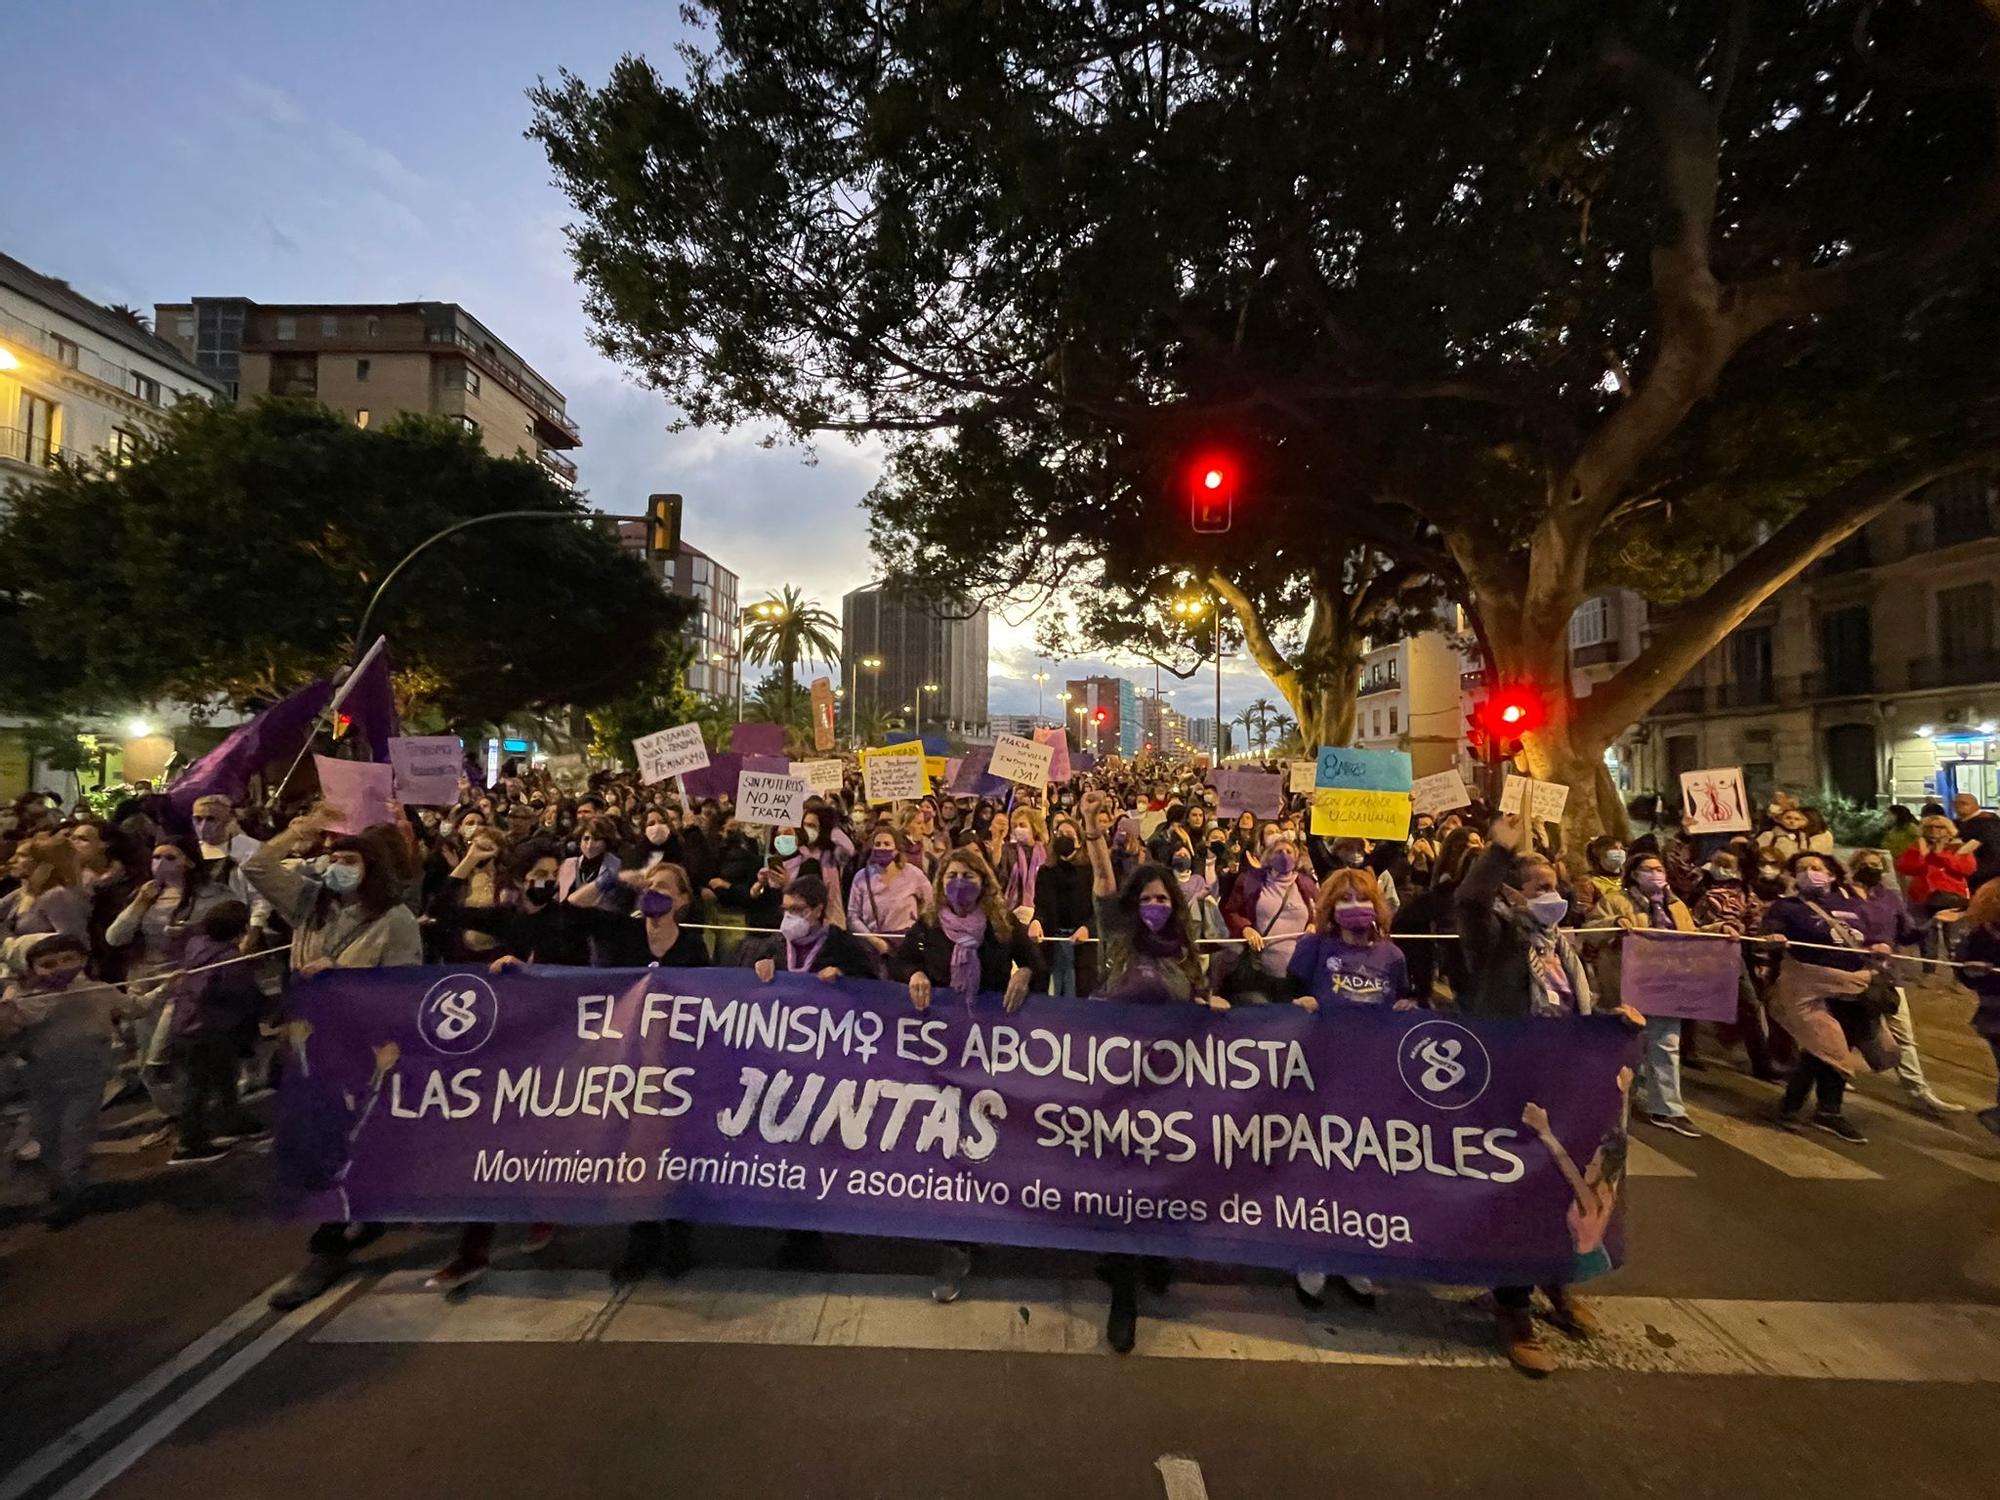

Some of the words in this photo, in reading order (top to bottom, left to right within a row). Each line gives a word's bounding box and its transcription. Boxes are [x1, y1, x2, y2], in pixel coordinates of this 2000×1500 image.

[655, 750, 705, 776] FEMINISMO
[743, 776, 760, 788] SIN
[762, 777, 805, 793] PUTEROS
[746, 791, 769, 805] NO
[772, 793, 793, 807] HAY
[751, 806, 791, 820] TRATA
[577, 996, 624, 1040] EL
[640, 993, 884, 1064] FEMINISMO
[896, 1018, 949, 1066] ES
[960, 1023, 1316, 1093] ABOLICIONISTA
[391, 1068, 482, 1120] LAS
[492, 1065, 696, 1124] MUJERES
[716, 1066, 1007, 1161] JUNTAS
[1034, 1102, 1198, 1165] SOMOS
[1212, 1113, 1525, 1183] IMPARABLES
[473, 1149, 647, 1184] Movimiento
[656, 1147, 807, 1191] feminista
[818, 1166, 838, 1201] y
[846, 1163, 1010, 1206] asociativo
[1021, 1179, 1062, 1210] de
[1073, 1189, 1208, 1225] mujeres
[1219, 1194, 1263, 1225] de
[1275, 1194, 1413, 1249] Málaga
